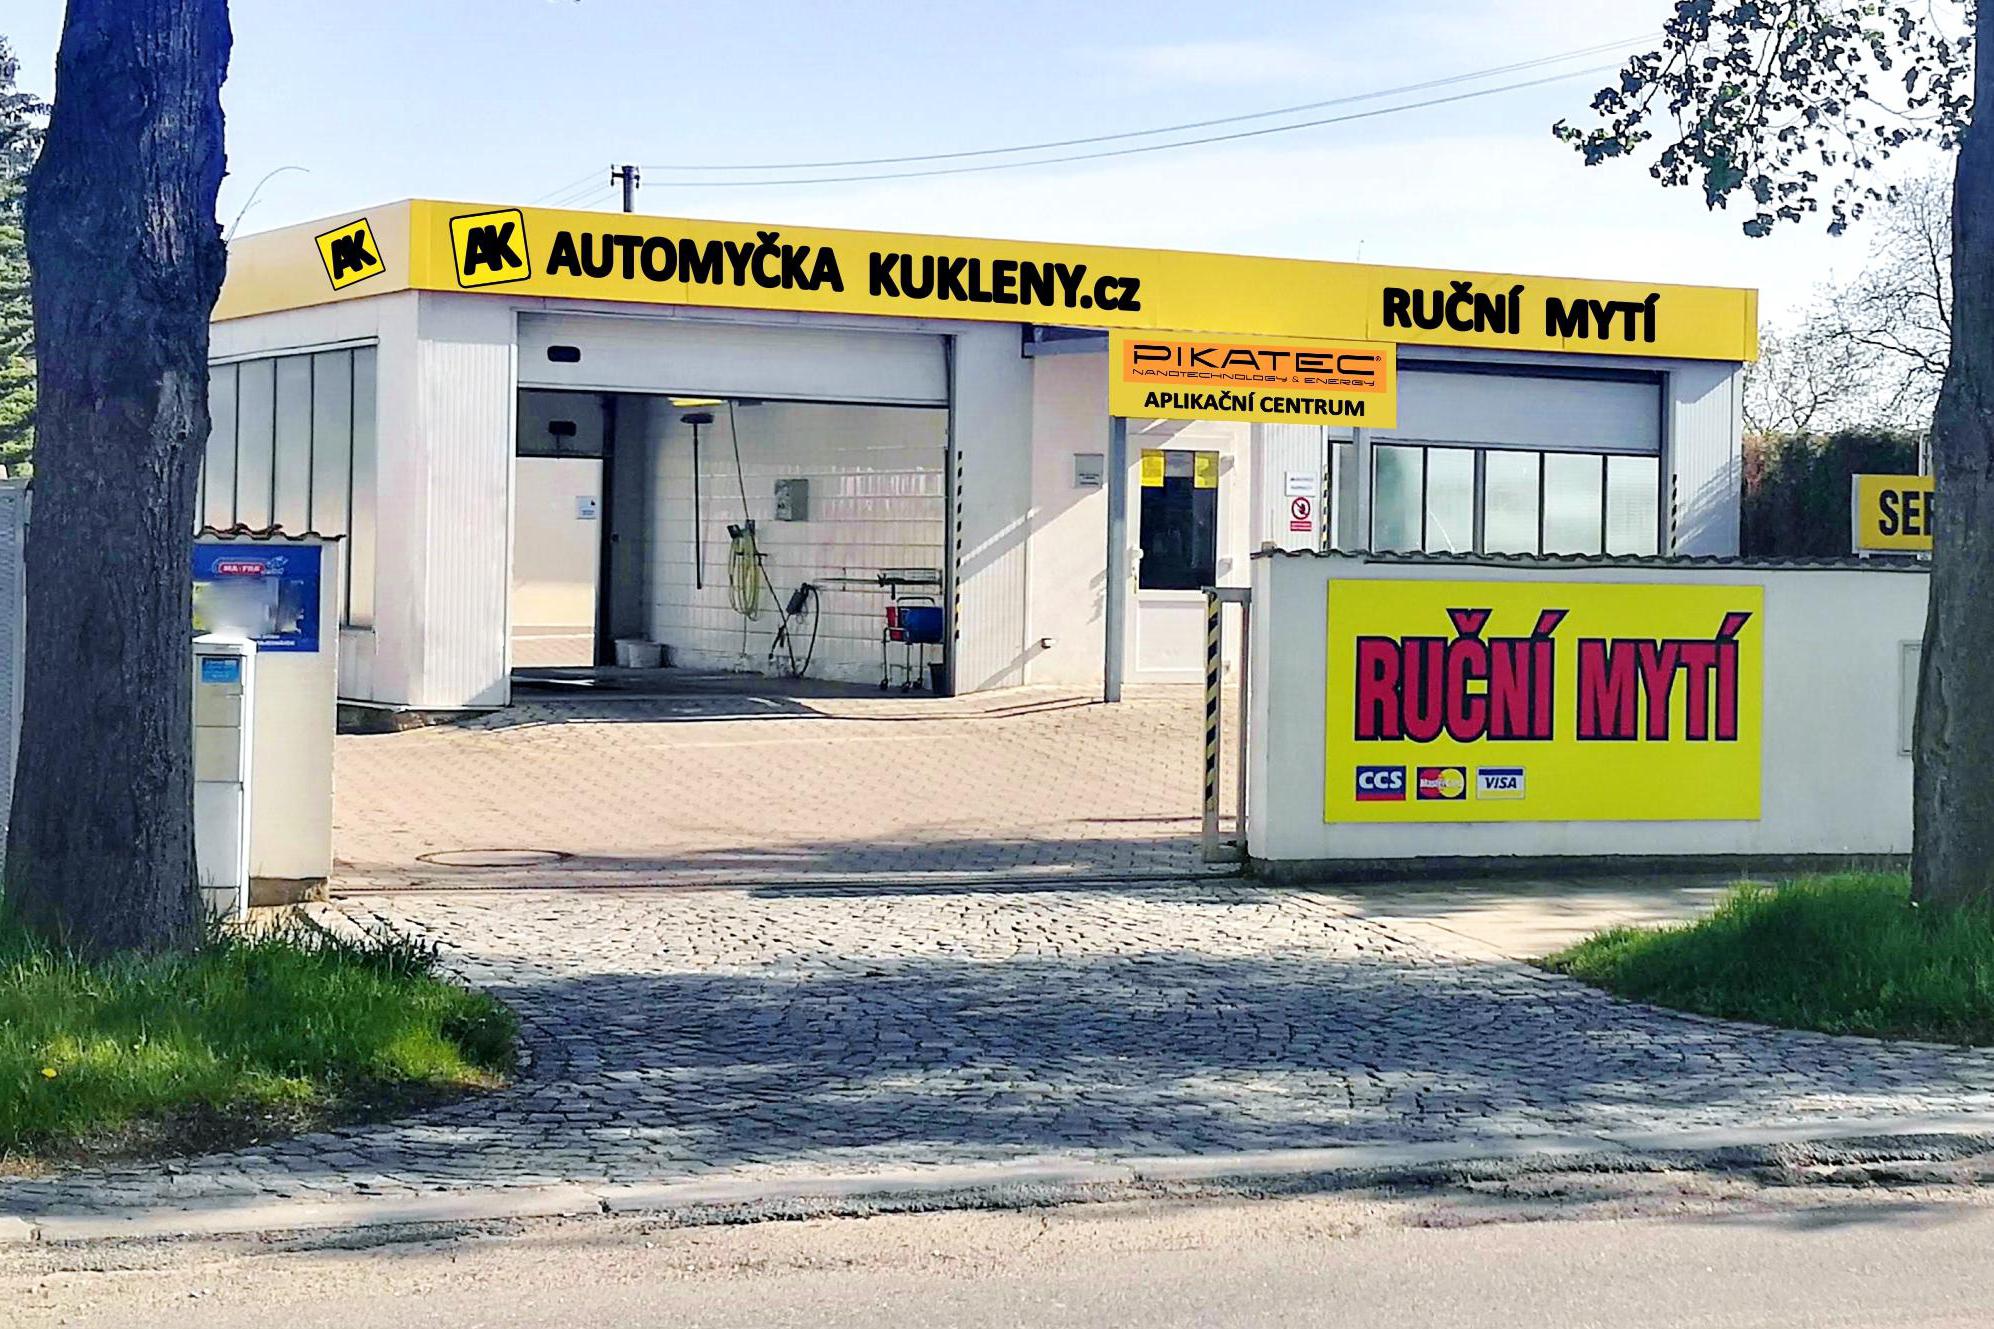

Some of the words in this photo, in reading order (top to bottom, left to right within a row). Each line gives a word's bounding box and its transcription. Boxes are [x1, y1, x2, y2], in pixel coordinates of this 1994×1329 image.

[331, 228, 378, 281] AK
[463, 221, 523, 276] AK
[546, 230, 845, 293] AUTOMYČKA
[868, 251, 1141, 312] KUKLENY.cz
[1383, 281, 1525, 335] RUČNÍ
[1545, 293, 1661, 343] MYTÍ
[1132, 368, 1288, 383] NANOTECHNOLOGY
[1304, 377, 1375, 386] ENERGY
[1144, 390, 1256, 412] APLIKAČNÍ
[1259, 396, 1365, 417] CENTRUM
[1354, 608, 1570, 743] RUČNÍ
[1576, 612, 1753, 742] MYTÍ
[1358, 771, 1403, 789] CCS
[1484, 776, 1518, 789] VISA
